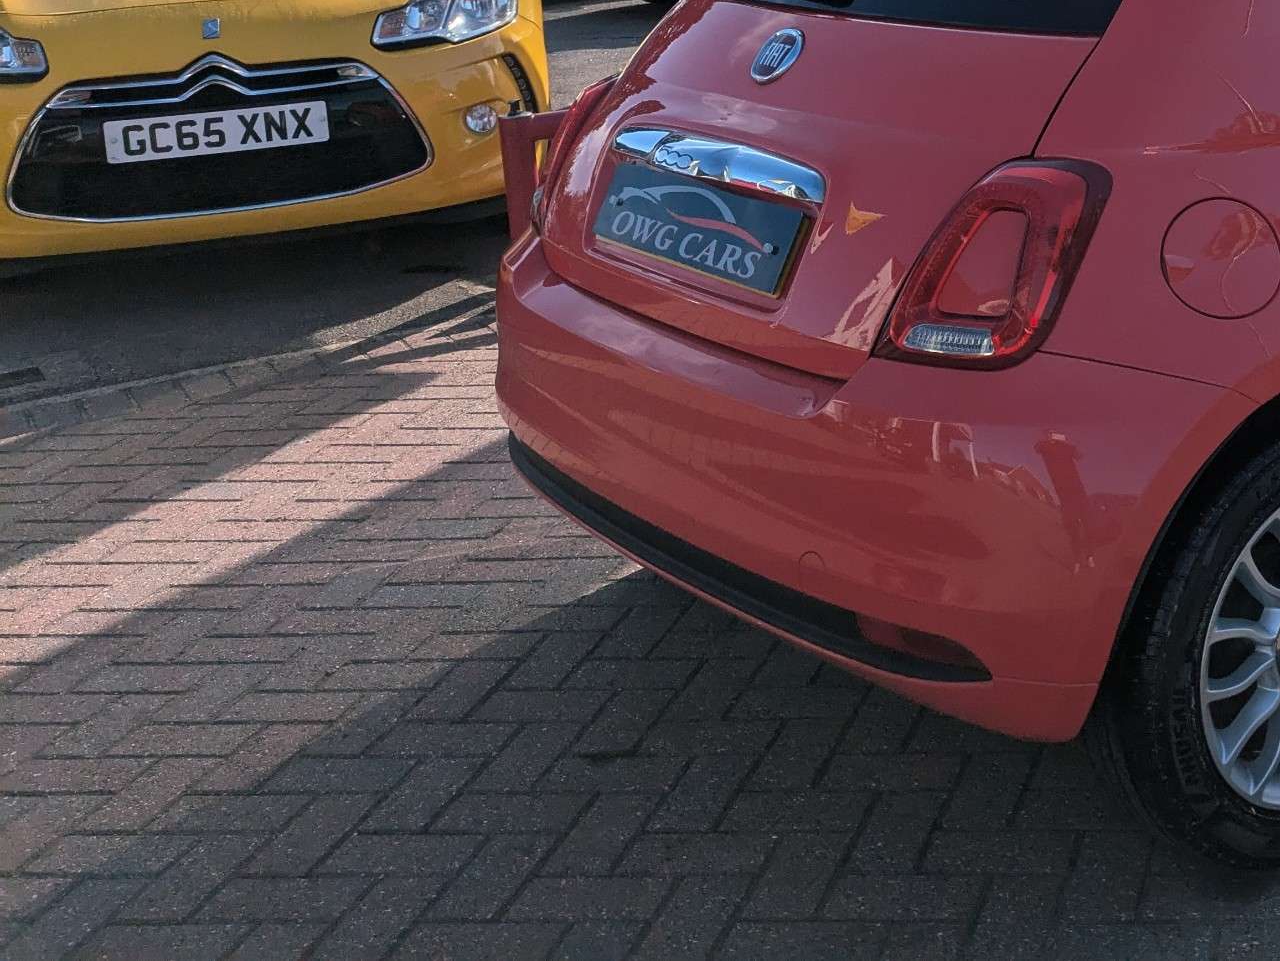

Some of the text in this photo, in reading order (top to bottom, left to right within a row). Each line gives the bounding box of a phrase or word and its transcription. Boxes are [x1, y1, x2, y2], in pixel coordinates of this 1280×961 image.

[121, 107, 315, 157] GC65 XNX
[611, 211, 762, 280] OWG CARS
